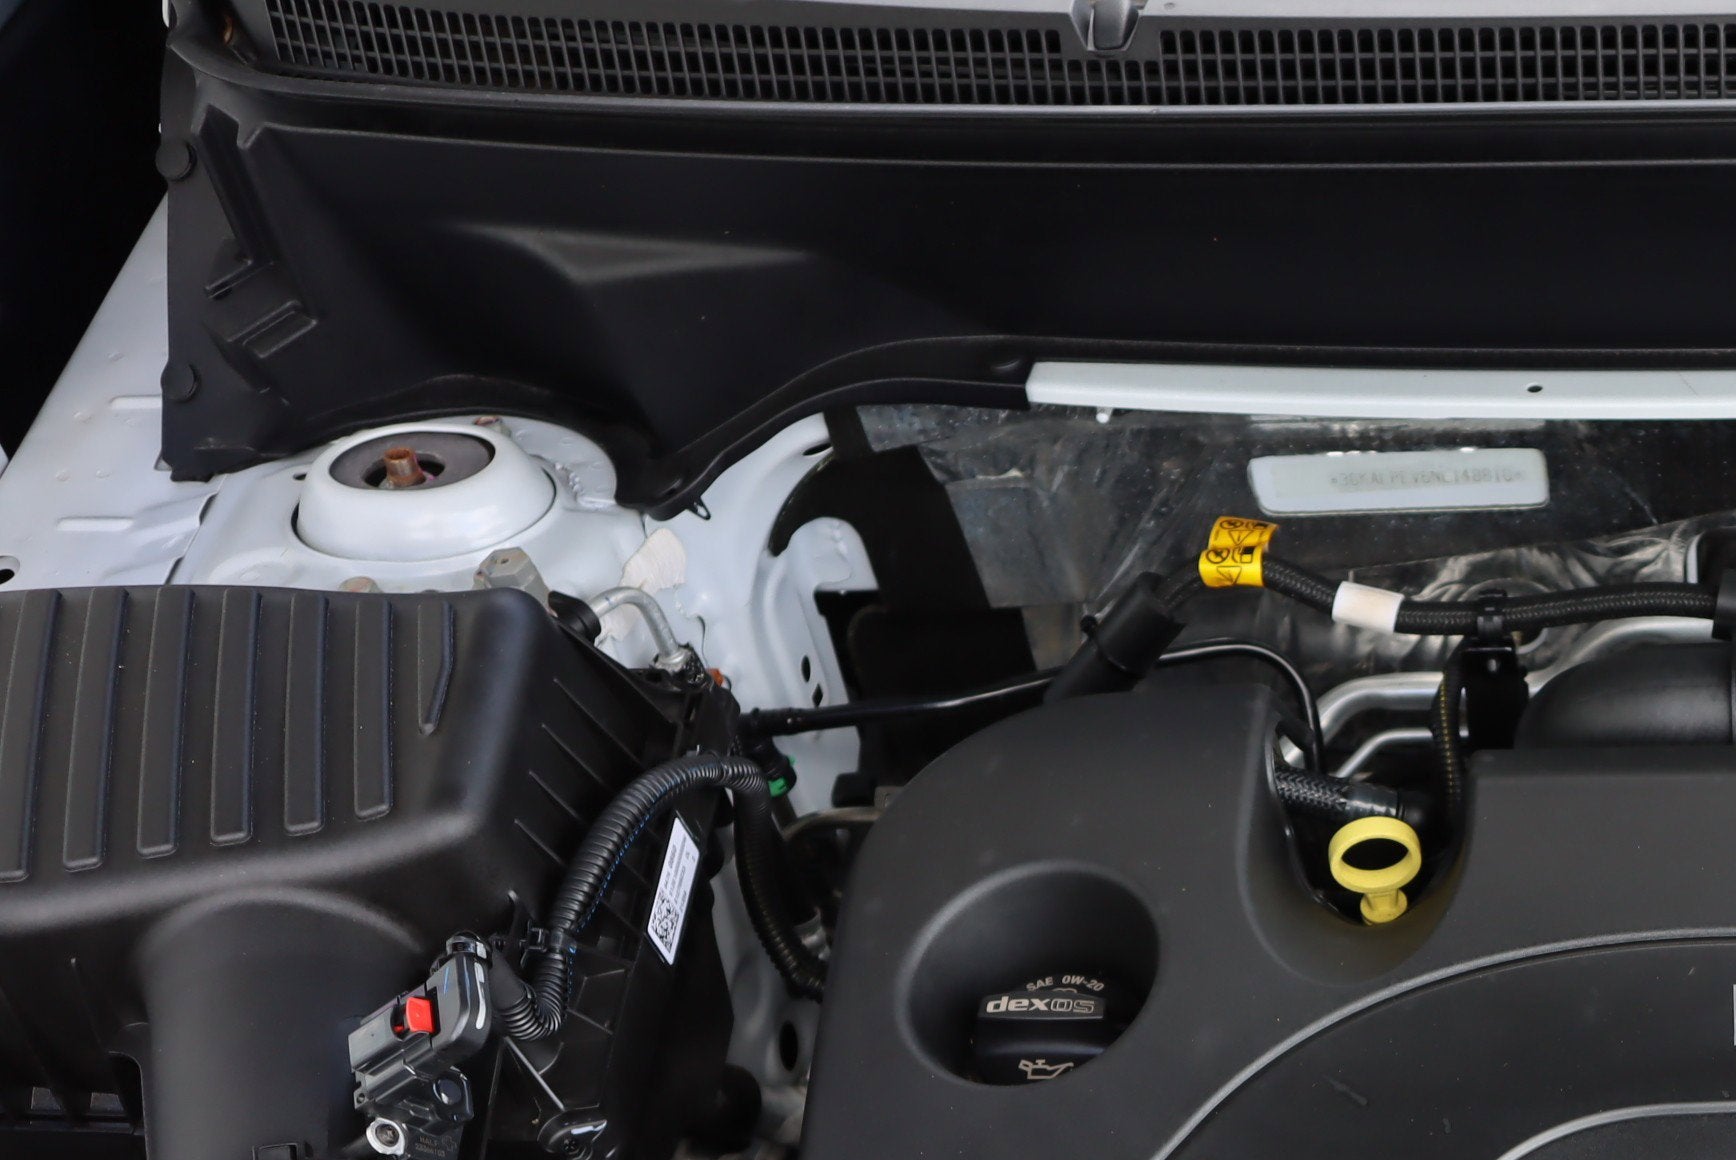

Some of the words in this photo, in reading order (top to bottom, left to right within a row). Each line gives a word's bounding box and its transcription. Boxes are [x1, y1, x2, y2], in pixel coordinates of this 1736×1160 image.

[1026, 976, 1054, 992] SAE
[1062, 975, 1105, 992] 0W-20
[986, 996, 1095, 1014] dexos
